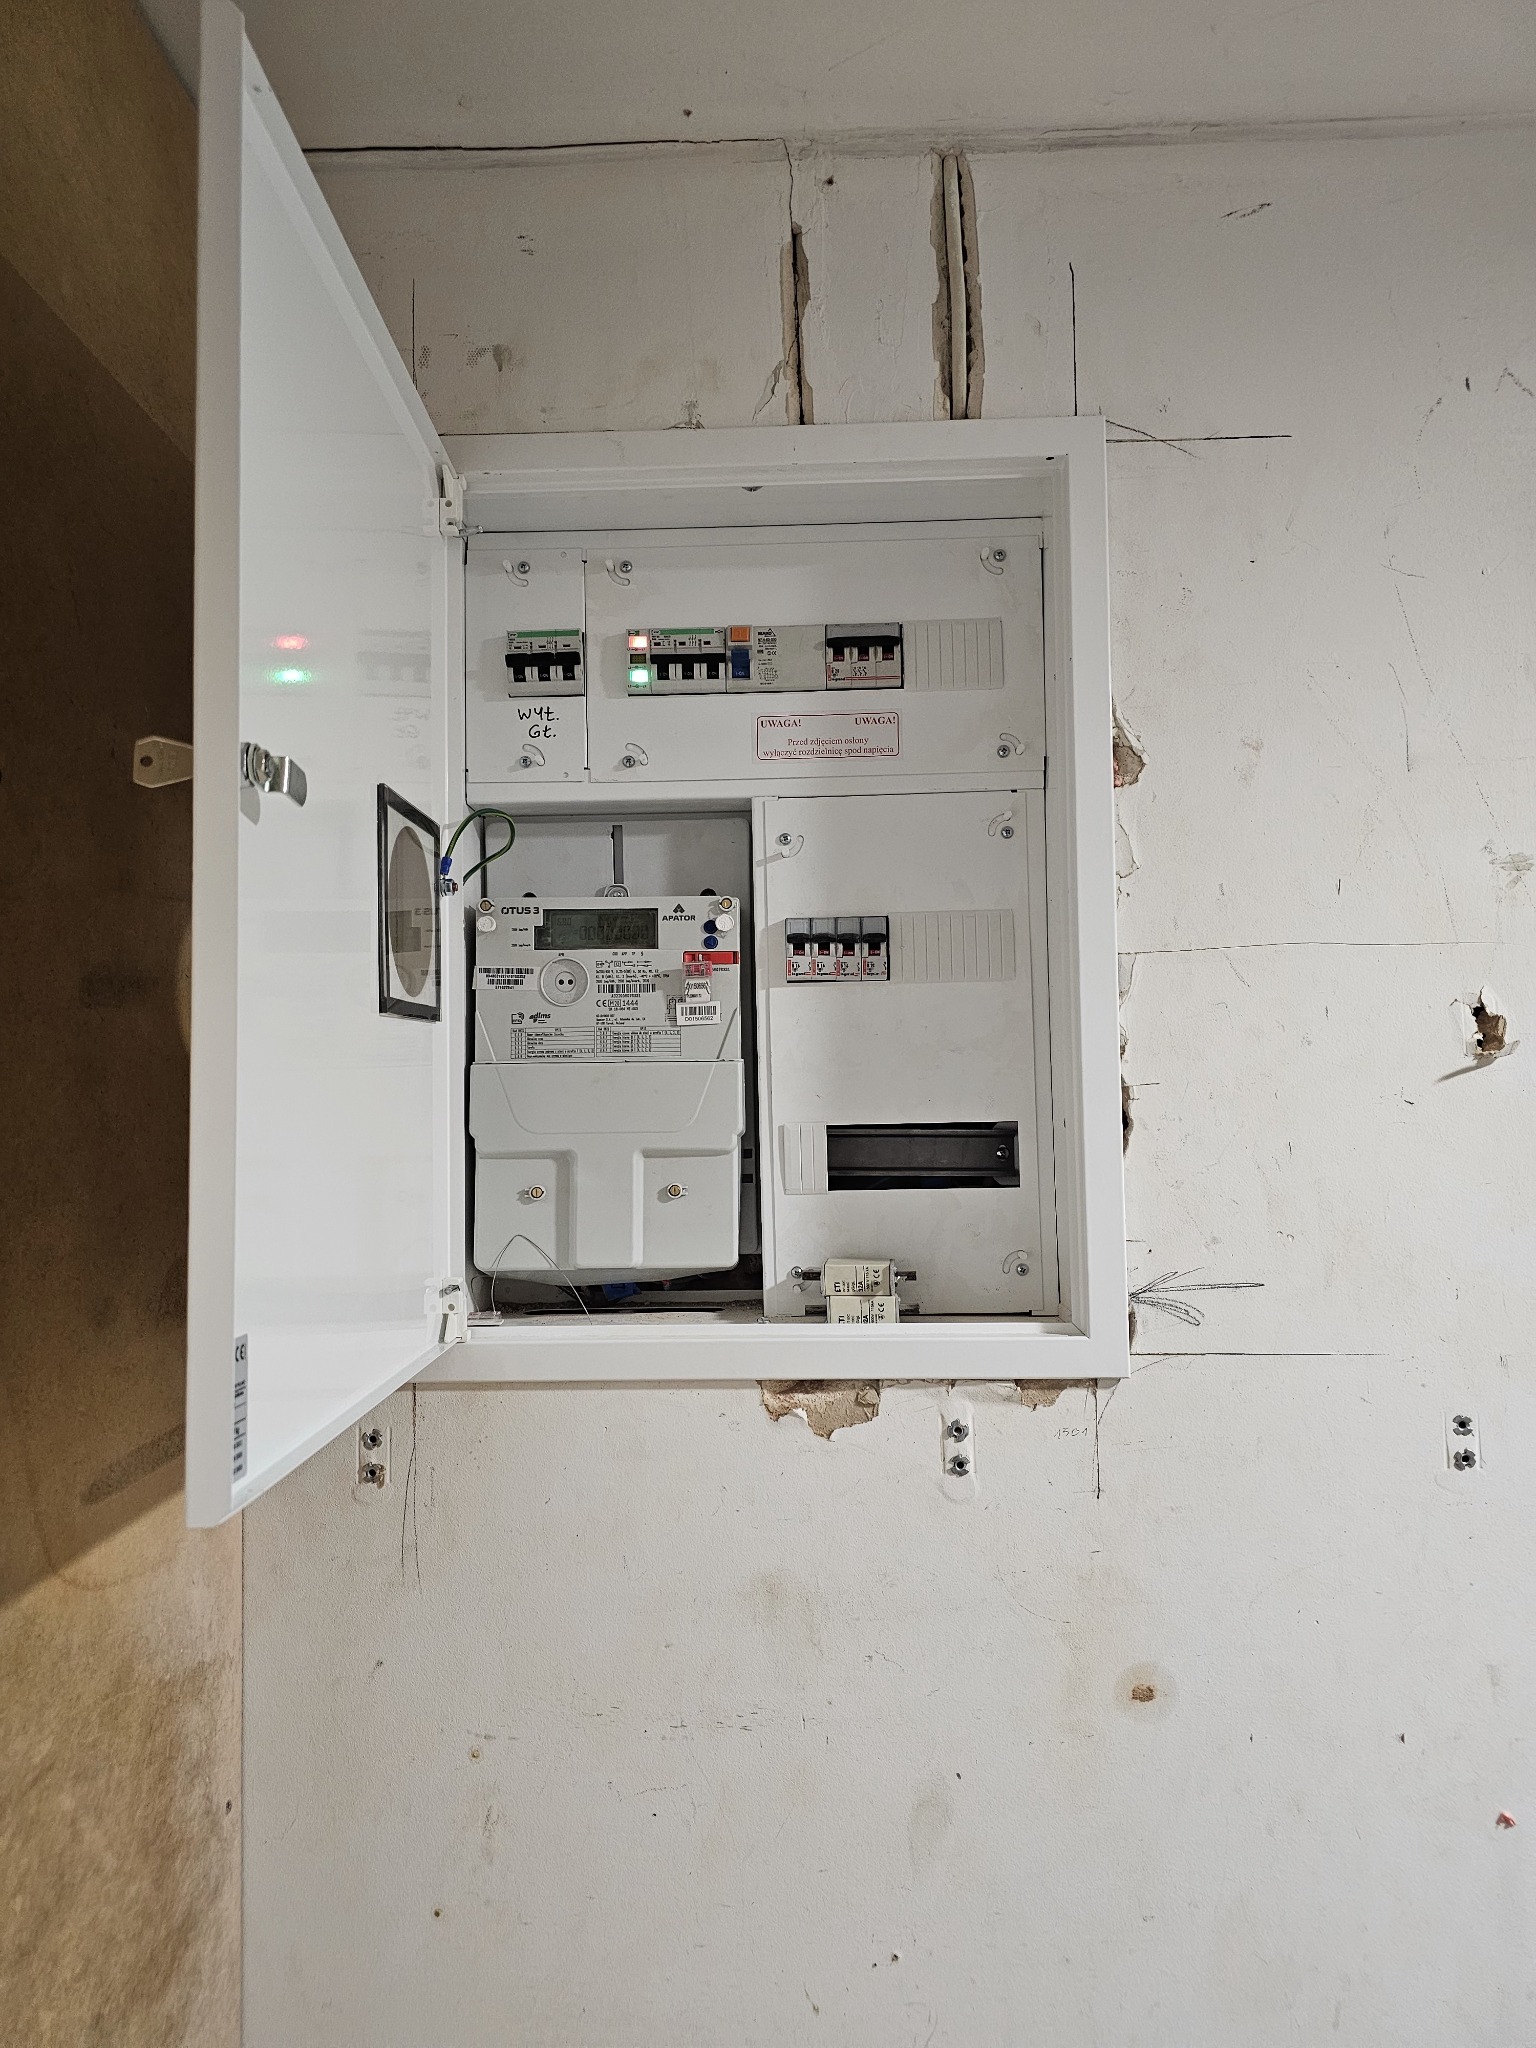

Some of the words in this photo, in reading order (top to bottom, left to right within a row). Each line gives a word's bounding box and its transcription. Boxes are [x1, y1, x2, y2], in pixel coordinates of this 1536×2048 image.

[760, 719, 802, 728] UWAGA!
[854, 716, 896, 726] UWAGA!
[787, 738, 808, 746] Przed
[810, 737, 843, 747] zdjęciem
[844, 736, 869, 746] osłony
[763, 748, 797, 758] wyłączyć
[798, 747, 842, 757] rozdzielnicę
[844, 746, 861, 756] spod
[863, 746, 894, 755] napięcia
[501, 906, 532, 915] OTUS
[533, 906, 540, 915] 3
[662, 914, 696, 922] APATOR
